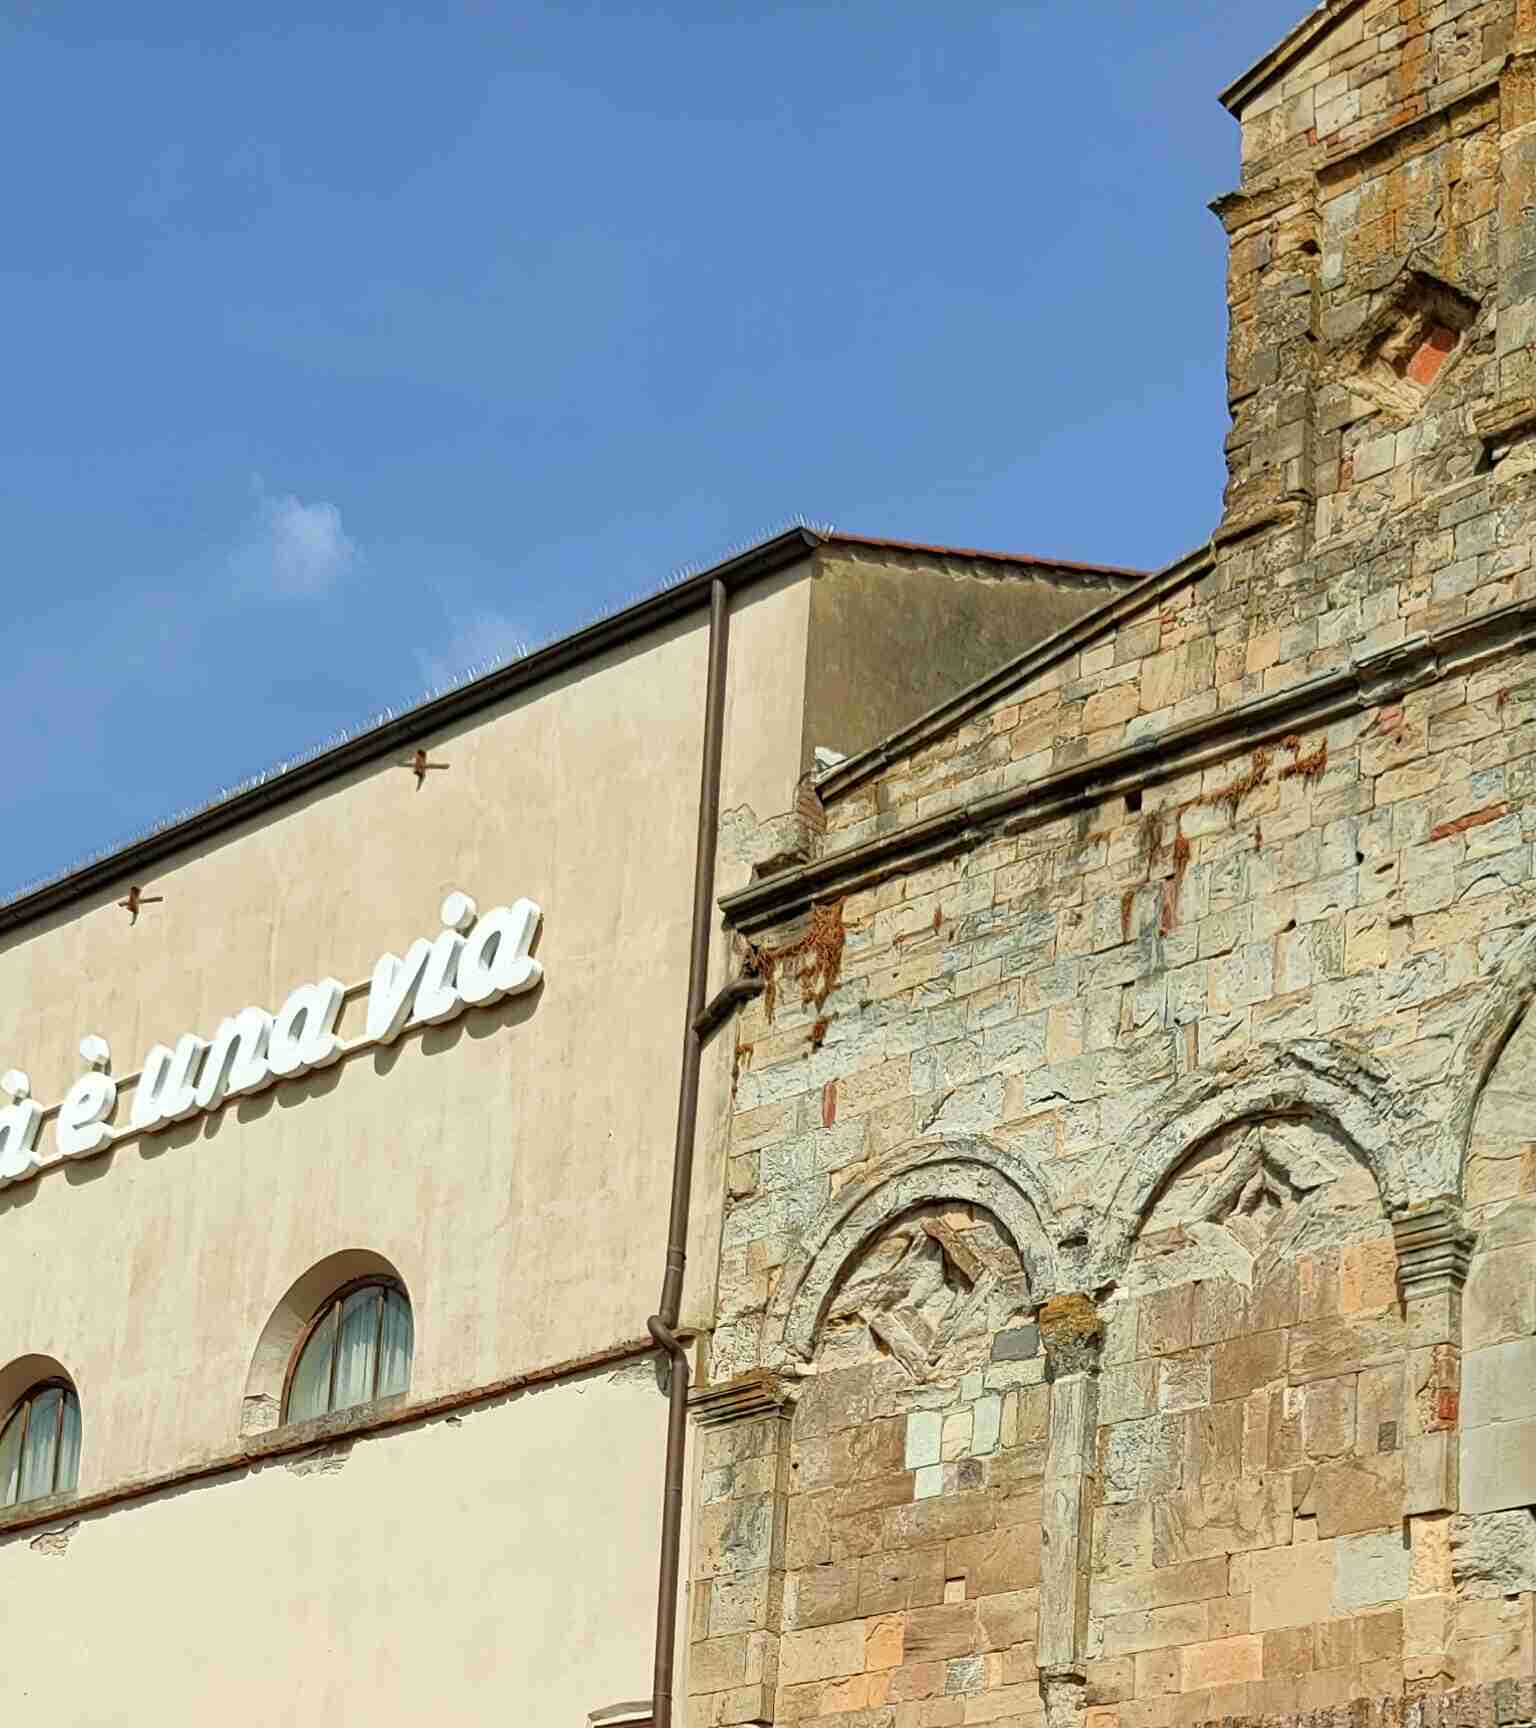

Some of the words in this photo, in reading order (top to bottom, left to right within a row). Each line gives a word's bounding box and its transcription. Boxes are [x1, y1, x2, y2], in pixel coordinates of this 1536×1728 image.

[56, 1034, 116, 1159] è
[130, 976, 346, 1128] una
[366, 889, 544, 1045] via
